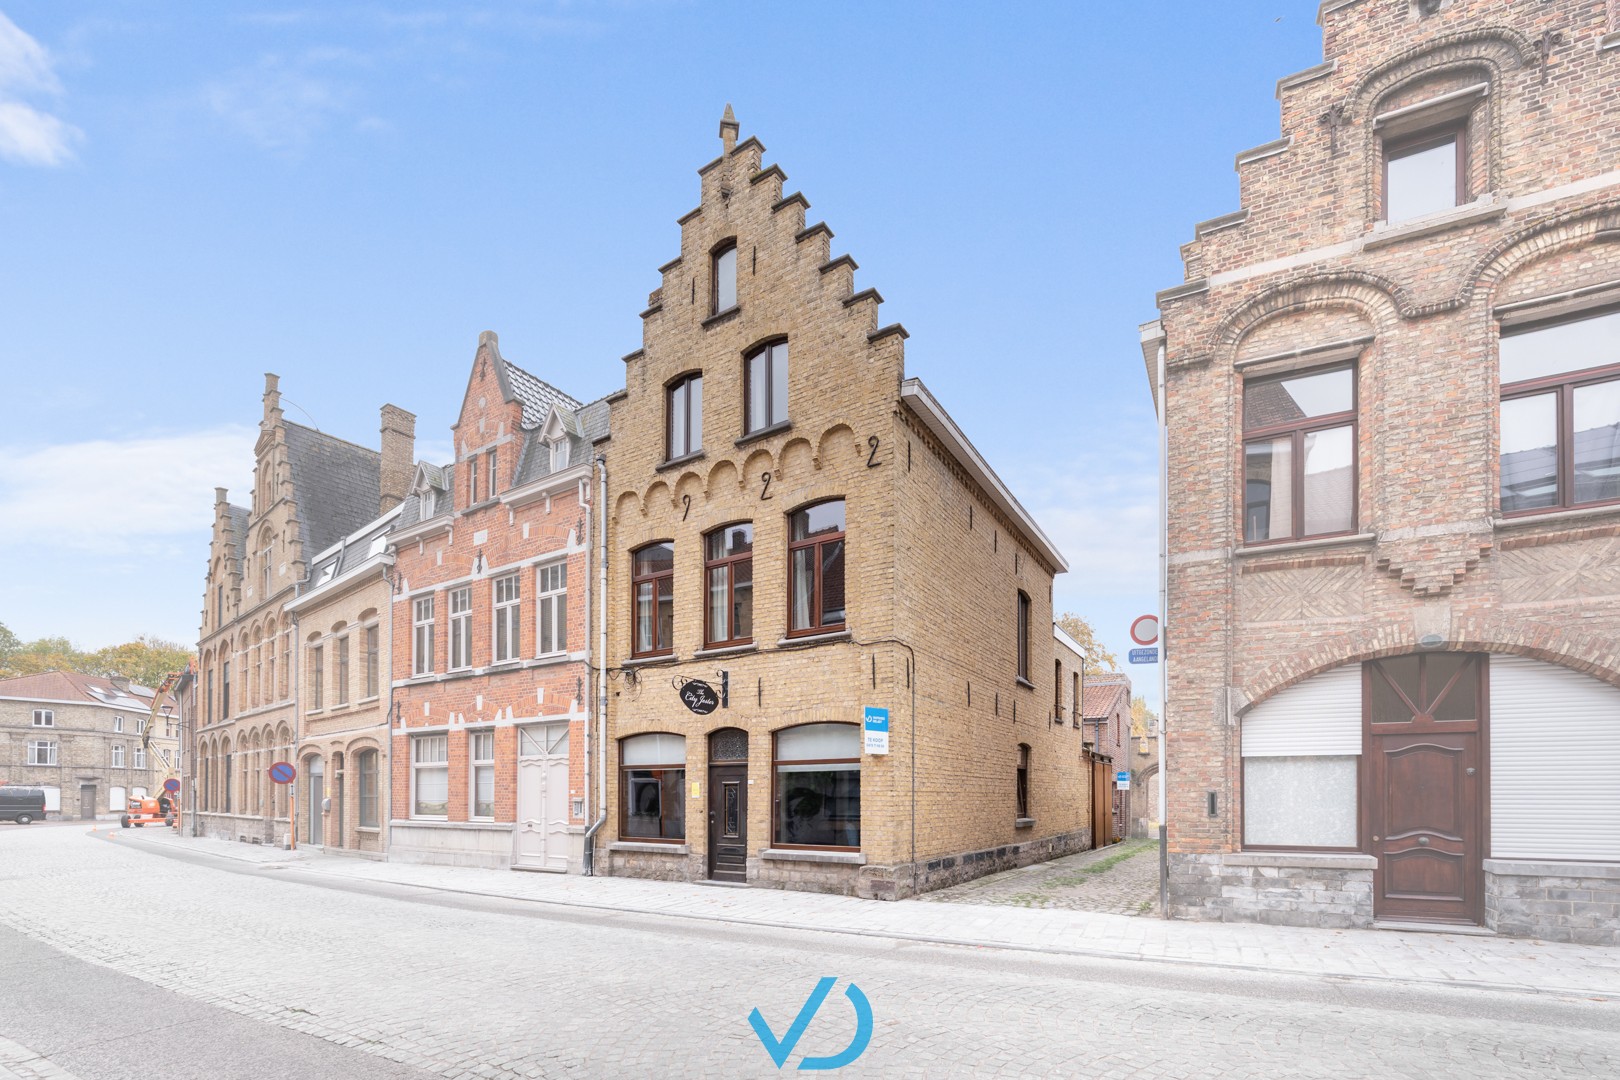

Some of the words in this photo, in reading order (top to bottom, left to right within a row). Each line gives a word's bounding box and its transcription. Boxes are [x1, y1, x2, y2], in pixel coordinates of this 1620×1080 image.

[760, 472, 773, 500] 2
[867, 435, 882, 468] 2
[685, 691, 698, 708] City
[695, 695, 715, 707] Jester
